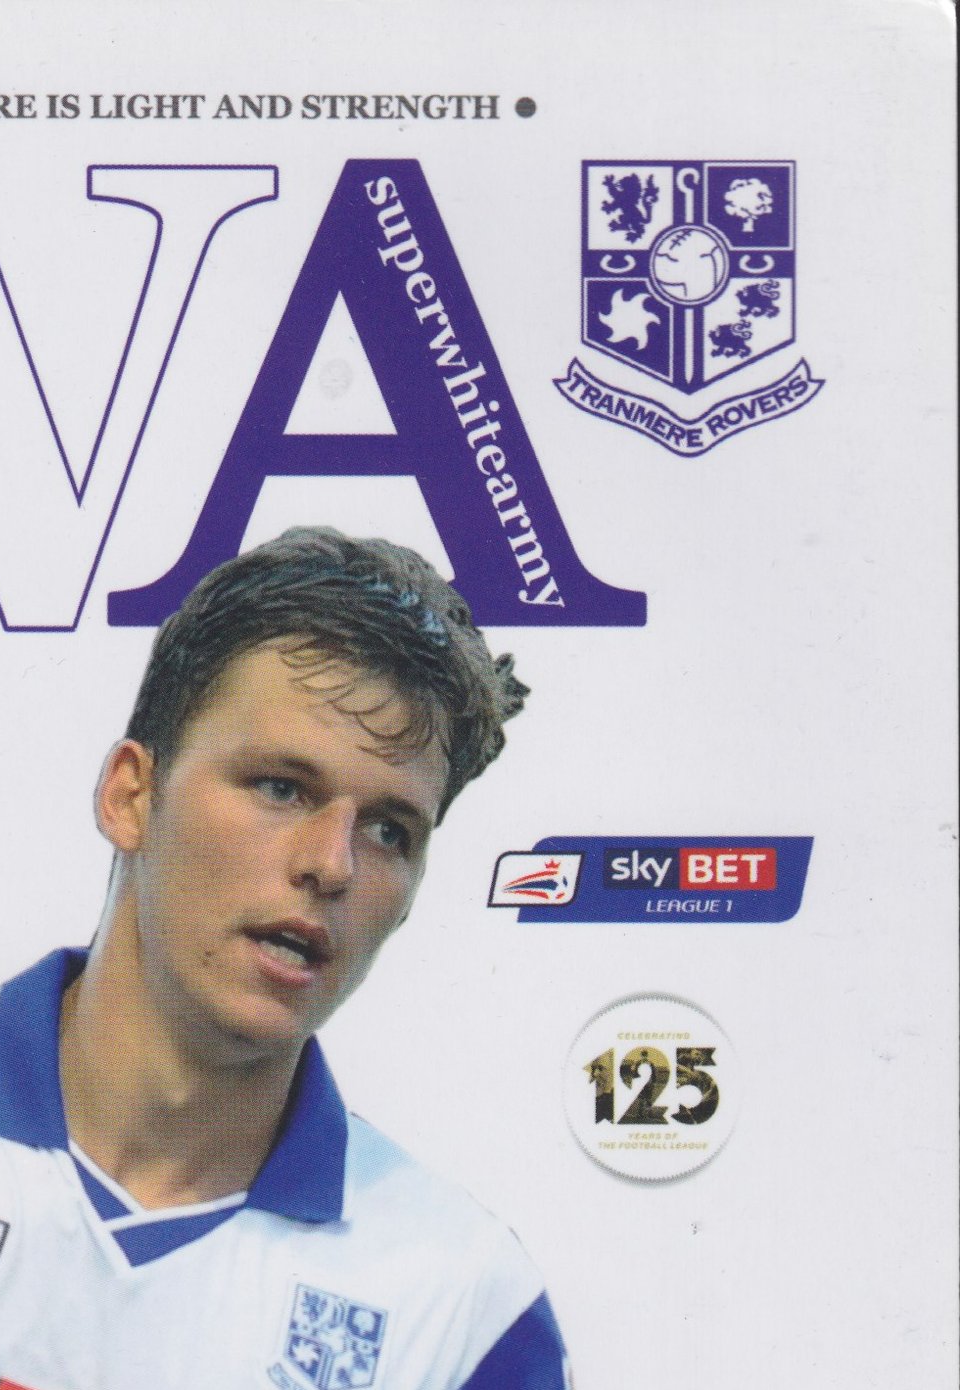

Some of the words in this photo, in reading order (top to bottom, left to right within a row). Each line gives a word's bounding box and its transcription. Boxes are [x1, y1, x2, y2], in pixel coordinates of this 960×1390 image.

[48, 94, 80, 119] IS
[91, 94, 205, 119] LIGHT
[213, 95, 292, 118] AND
[302, 95, 498, 119] STRENGTH
[365, 176, 565, 607] superwhitearmy
[567, 372, 703, 447] TRANMERE
[706, 375, 809, 437] ROVERS
[611, 849, 672, 887] sky
[688, 854, 767, 883] BET
[646, 899, 720, 913] LEAGUE
[724, 899, 733, 913] 1
[583, 1046, 719, 1125] 125
